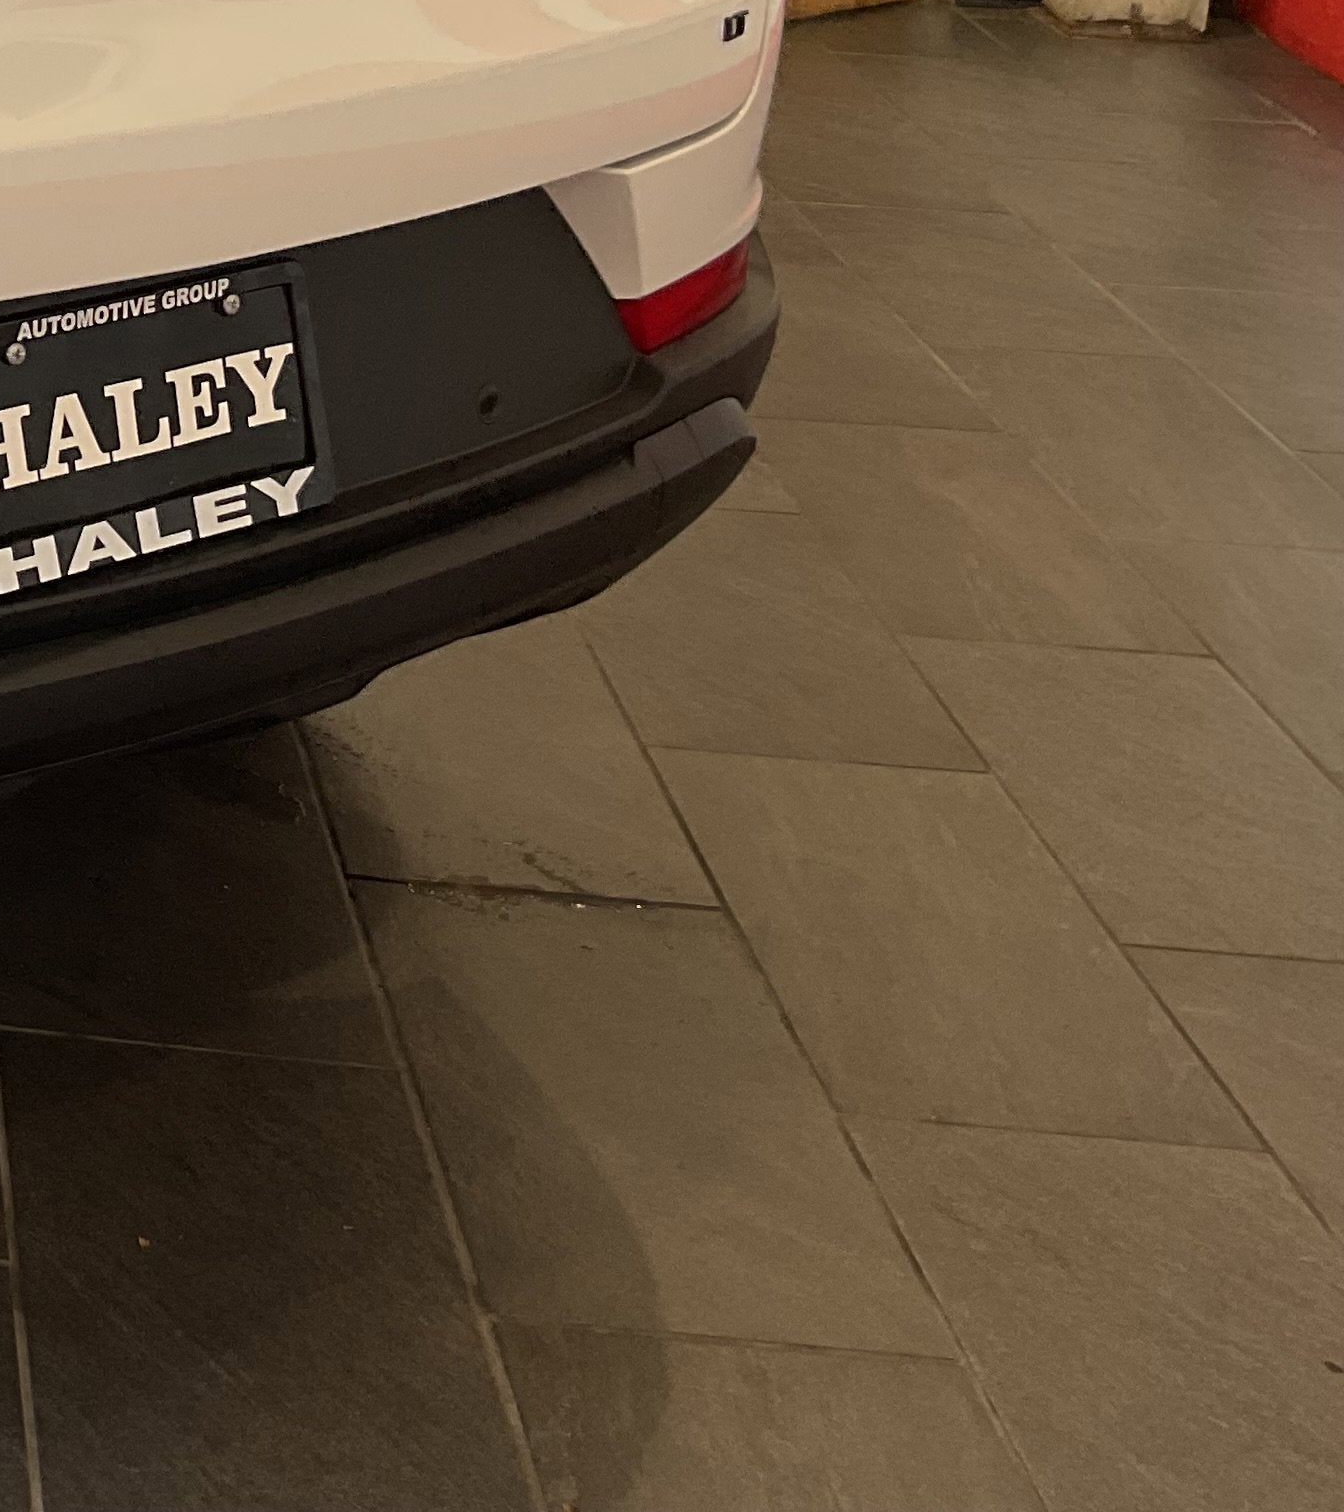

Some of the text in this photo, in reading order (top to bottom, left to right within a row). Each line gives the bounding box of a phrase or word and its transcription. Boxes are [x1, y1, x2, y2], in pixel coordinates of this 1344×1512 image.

[722, 9, 749, 42] LT
[16, 277, 230, 343] AUTOMOTIVE GROUP
